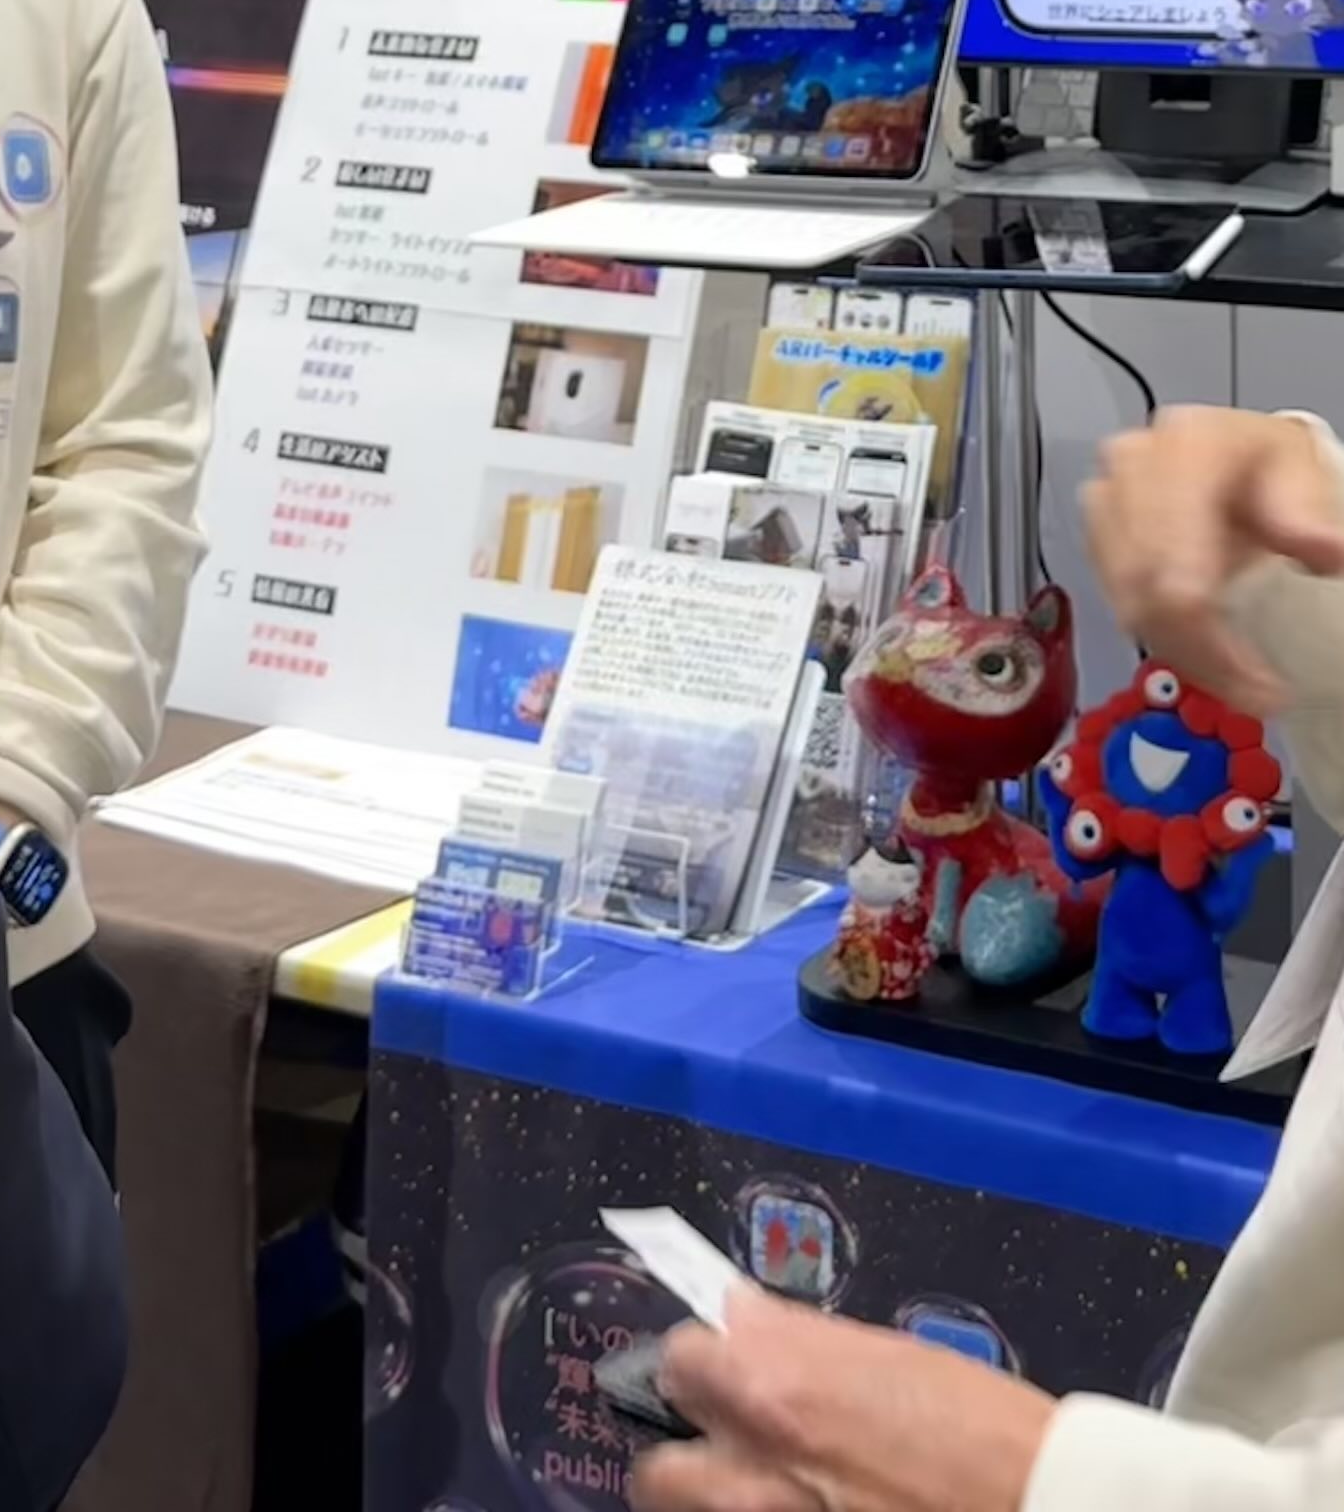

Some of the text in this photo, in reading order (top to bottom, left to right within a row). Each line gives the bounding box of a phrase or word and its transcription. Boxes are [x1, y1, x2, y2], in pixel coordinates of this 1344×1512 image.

[300, 156, 323, 184] 2
[272, 289, 292, 317] 3
[241, 427, 261, 456] 4
[214, 569, 237, 599] 5
